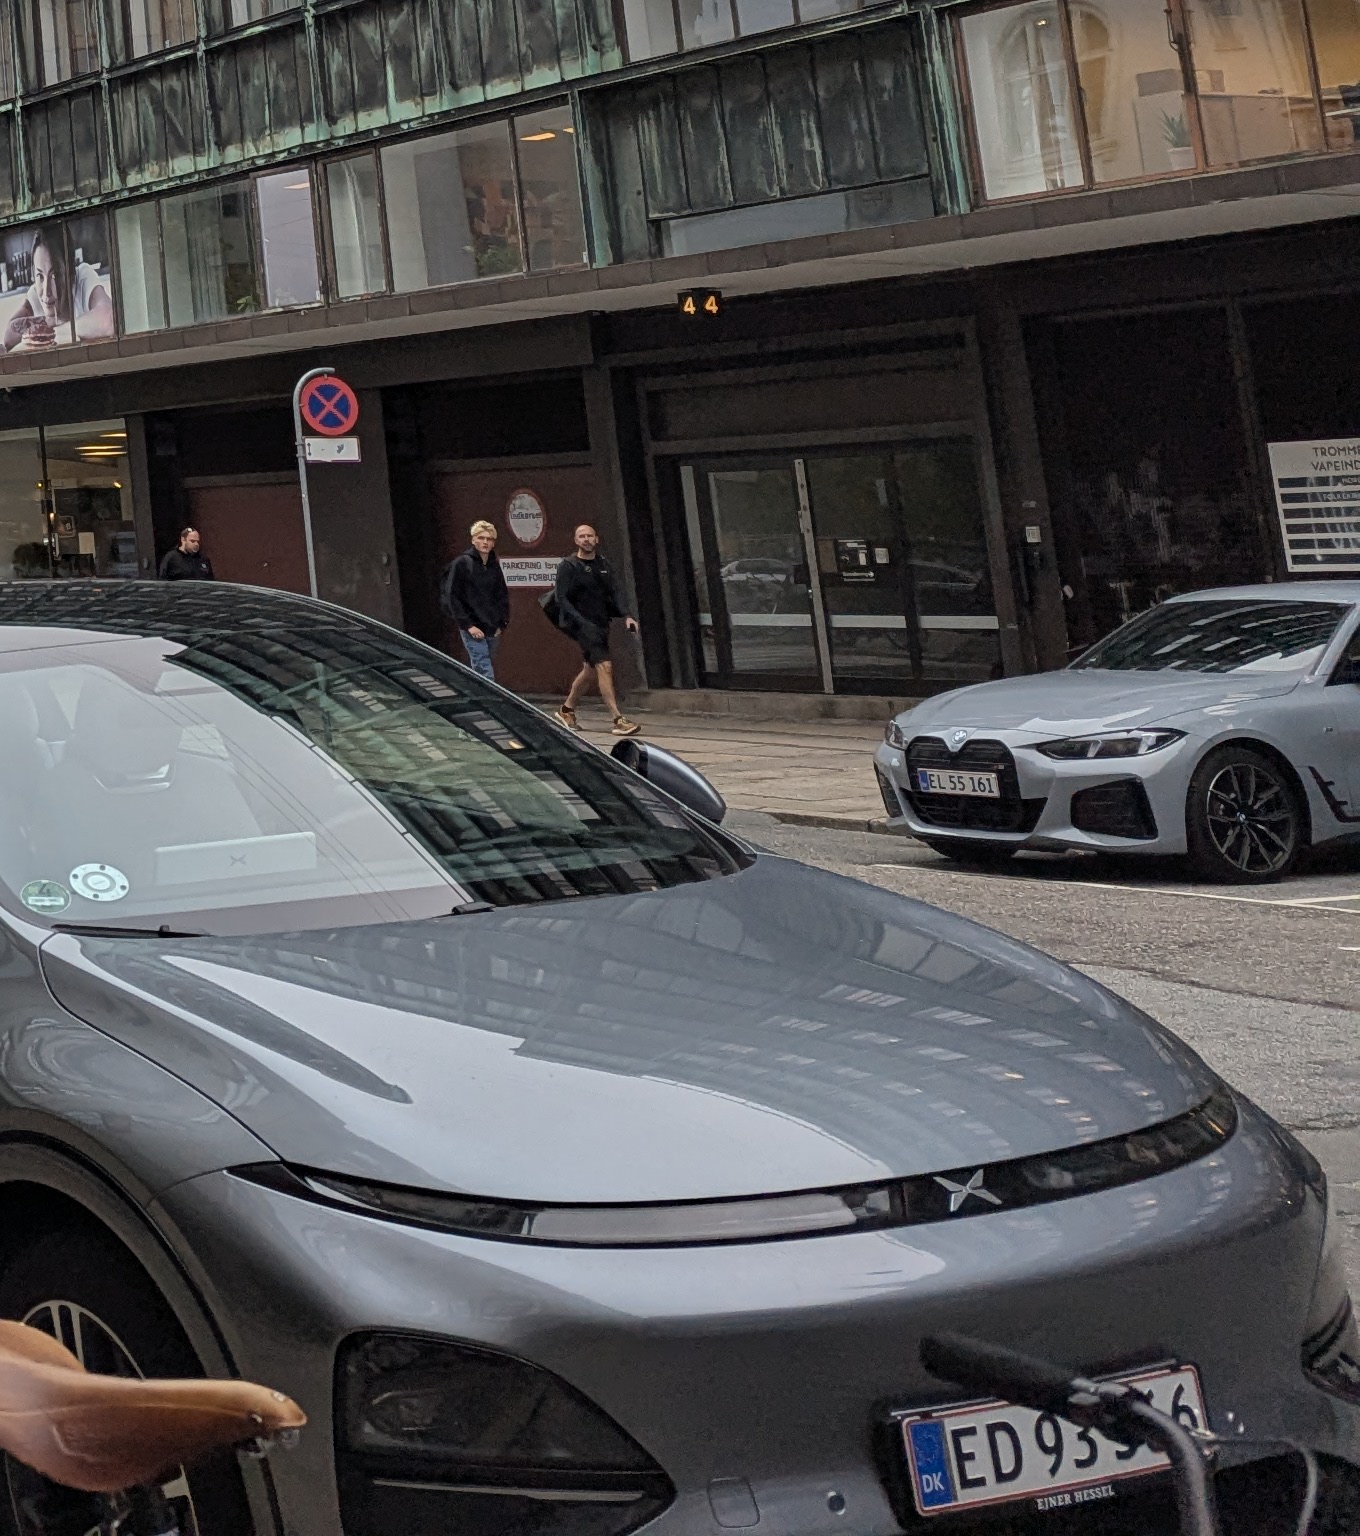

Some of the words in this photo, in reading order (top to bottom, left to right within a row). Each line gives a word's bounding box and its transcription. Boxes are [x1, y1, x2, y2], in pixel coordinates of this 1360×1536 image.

[502, 562, 542, 570] PARKERING
[929, 774, 946, 790] EL
[949, 775, 966, 791] 55
[970, 777, 994, 793] 161
[922, 1474, 944, 1493] DK
[951, 1421, 1023, 1490] ED
[1035, 1413, 1099, 1478] 93
[1037, 1493, 1072, 1510] EJNER
[1074, 1485, 1115, 1503] HESSEL
